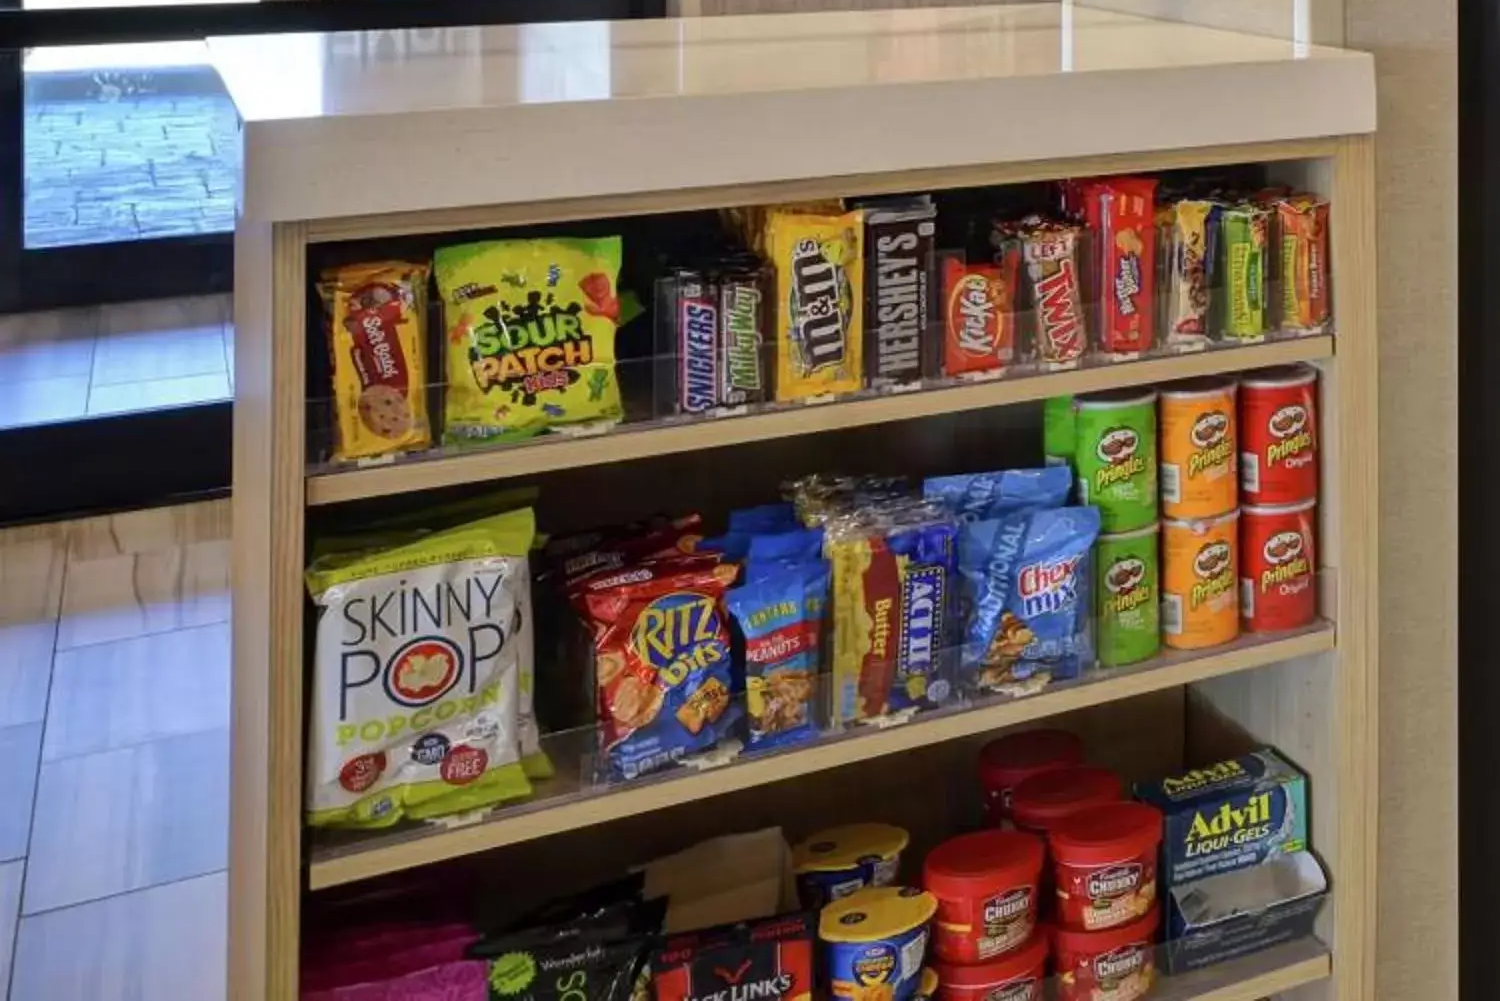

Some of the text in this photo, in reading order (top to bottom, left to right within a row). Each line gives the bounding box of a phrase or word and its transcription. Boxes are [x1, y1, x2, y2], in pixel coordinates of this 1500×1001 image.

[362, 315, 386, 346] Soft
[877, 233, 919, 378] HERSHEY'S
[1035, 258, 1084, 359] TWIX
[475, 313, 582, 357] SOUR
[685, 301, 716, 411] SNICKERS
[472, 337, 593, 389] PATCH
[908, 579, 935, 628] ACT
[1017, 556, 1082, 600] Chex
[638, 598, 715, 660] RITZ
[745, 635, 802, 663] PEANUTS
[874, 598, 893, 659] Butter
[339, 622, 504, 721] POP
[335, 681, 502, 747] POPCORN
[417, 745, 446, 761] GMO
[447, 759, 481, 780] FREE
[1185, 792, 1271, 842] Advil
